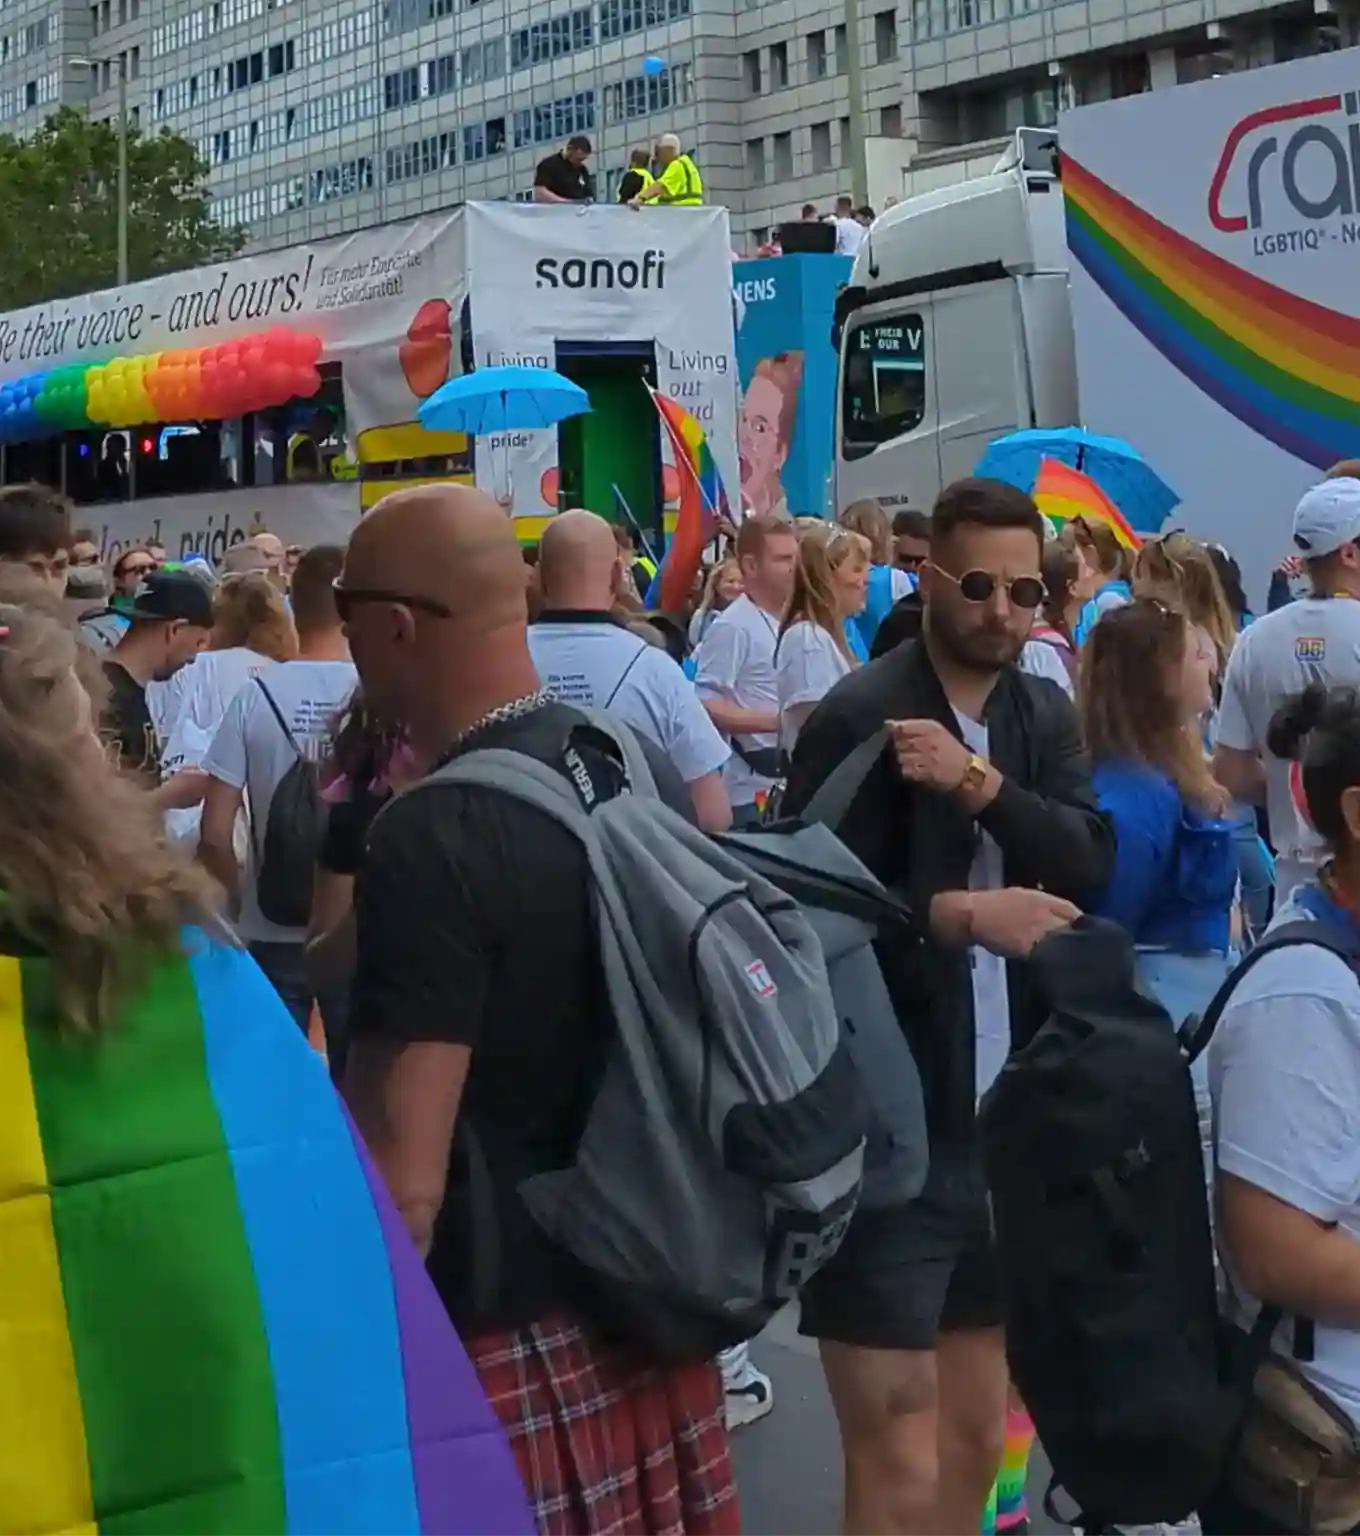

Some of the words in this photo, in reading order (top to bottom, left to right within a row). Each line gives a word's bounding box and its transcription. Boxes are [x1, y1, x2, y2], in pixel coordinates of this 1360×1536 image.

[535, 250, 665, 290] sanofi
[18, 307, 76, 361] their
[77, 295, 142, 348] voice
[169, 272, 229, 333] and
[228, 254, 315, 321] ours!
[669, 350, 727, 374] Living
[670, 380, 702, 398] out
